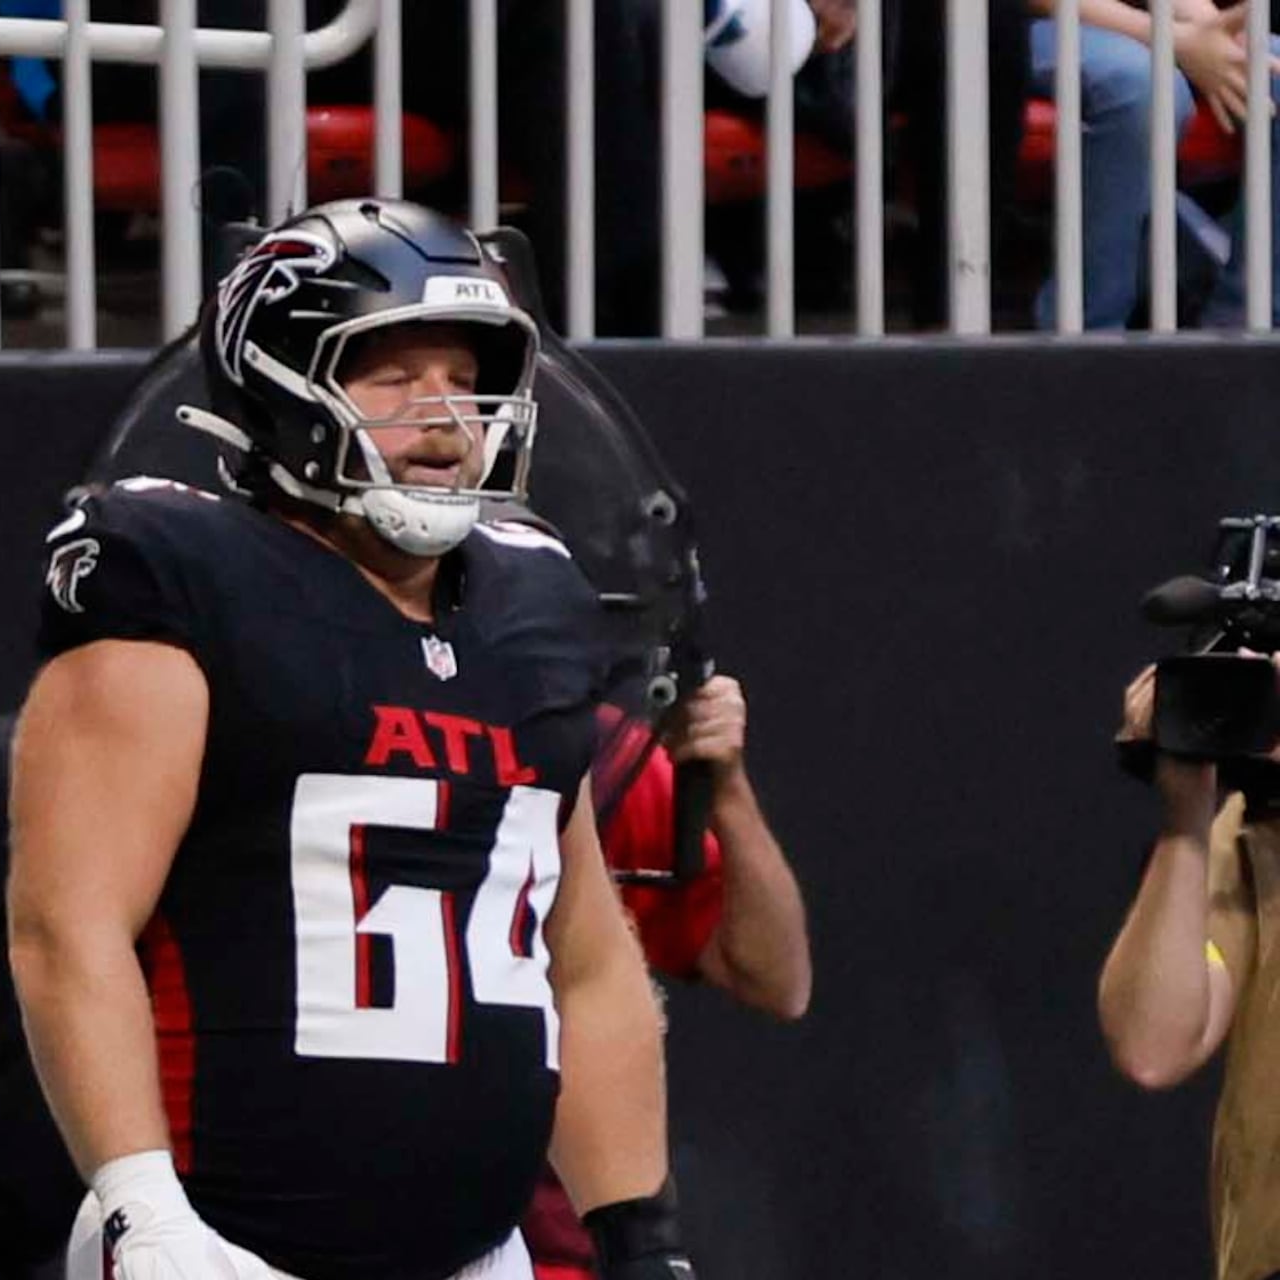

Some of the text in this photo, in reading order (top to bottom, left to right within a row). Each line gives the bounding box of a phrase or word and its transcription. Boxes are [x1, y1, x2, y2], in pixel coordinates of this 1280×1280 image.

[455, 283, 495, 300] ATL
[364, 704, 537, 786] ATL
[291, 774, 562, 1071] 64
